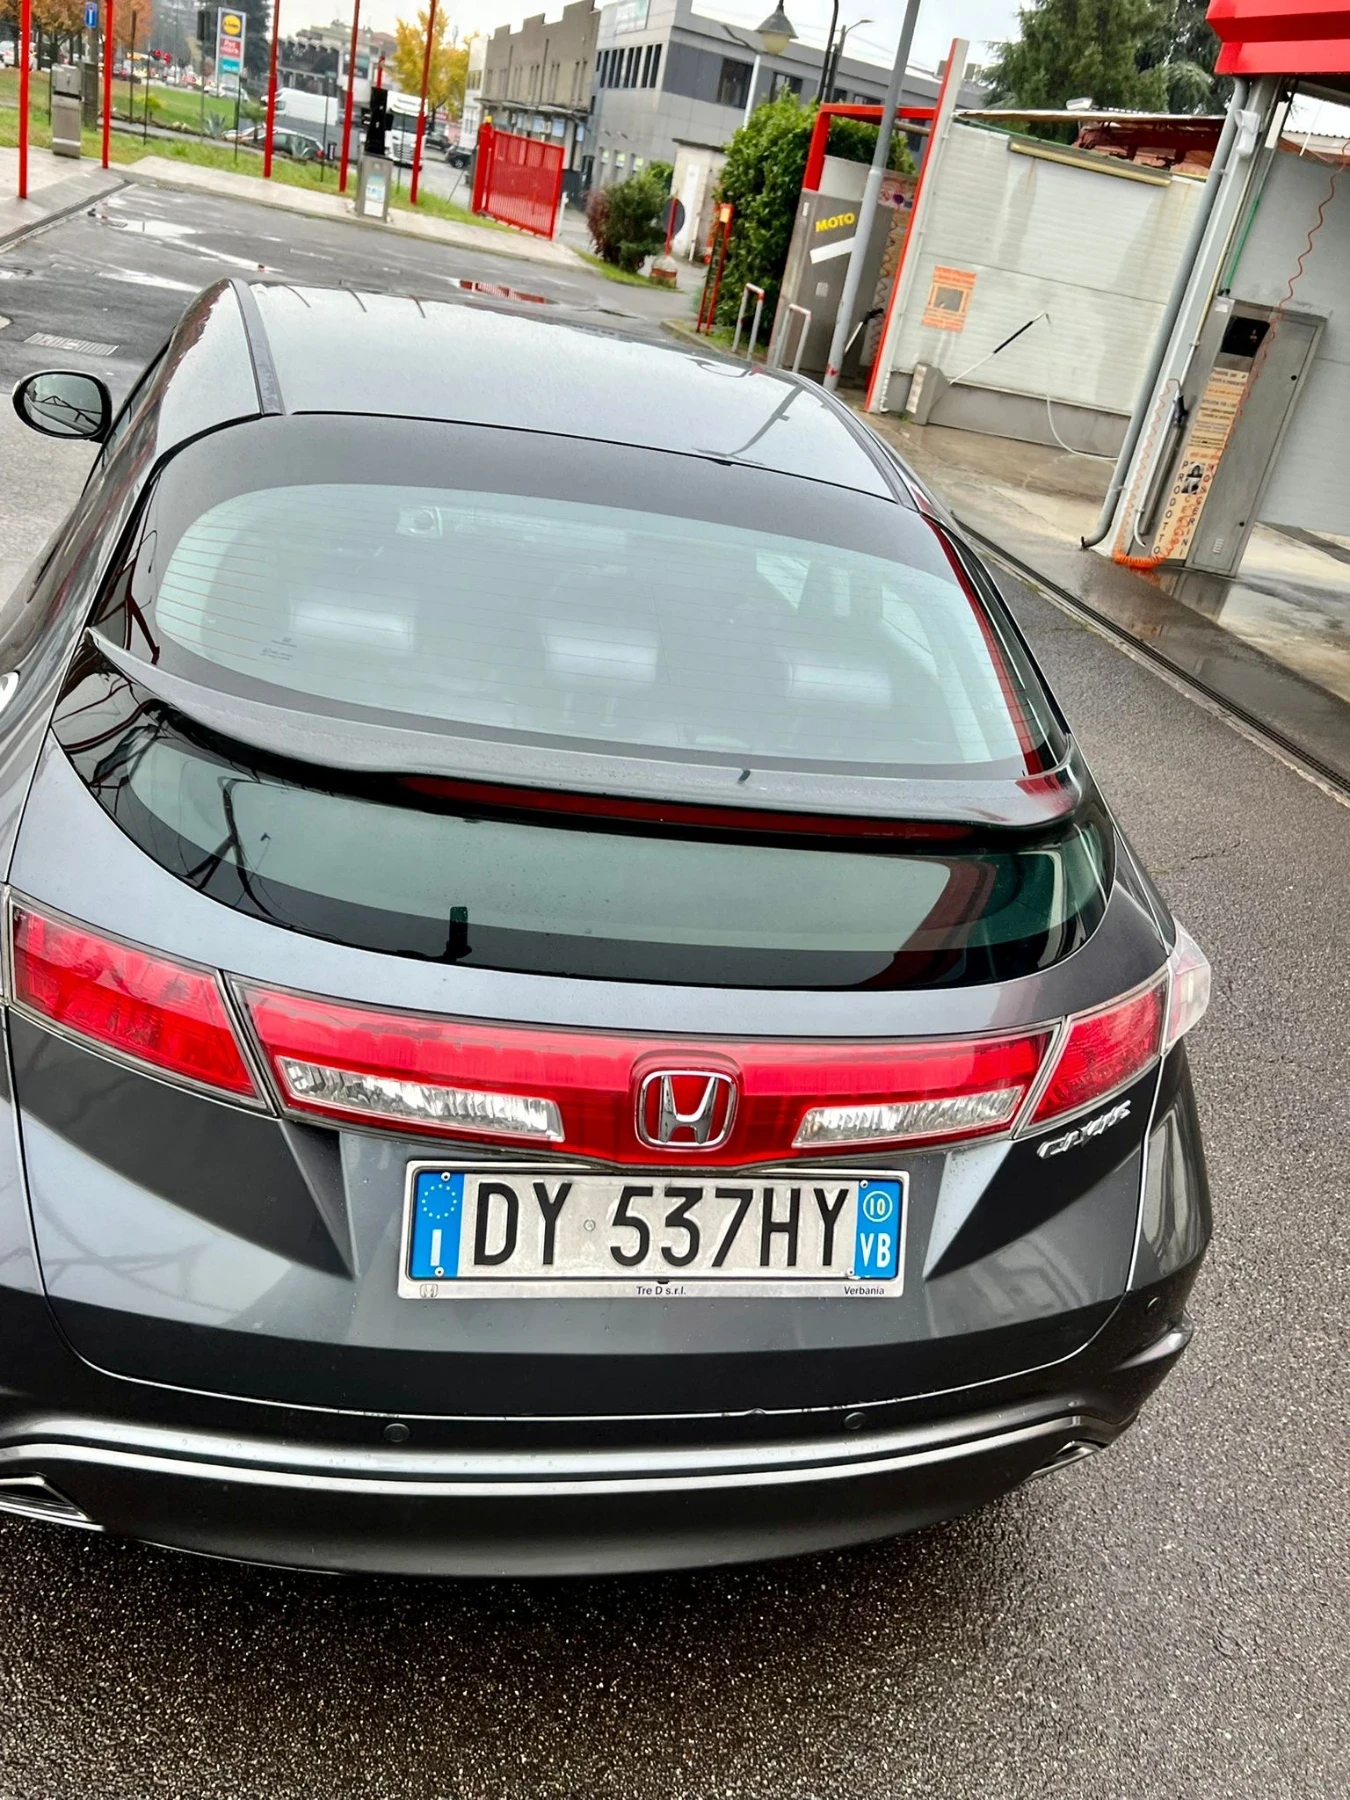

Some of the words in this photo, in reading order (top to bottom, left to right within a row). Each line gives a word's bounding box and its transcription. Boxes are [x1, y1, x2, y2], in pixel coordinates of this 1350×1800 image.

[815, 212, 855, 232] MOTO
[473, 1182, 572, 1267] DY
[609, 1186, 850, 1268] 537HY
[430, 1229, 442, 1267] I
[859, 1232, 892, 1269] VB
[636, 1286, 653, 1295] Tre
[655, 1286, 664, 1295] D
[665, 1286, 687, 1295] s.r.l.
[844, 1286, 885, 1296] Verbania
